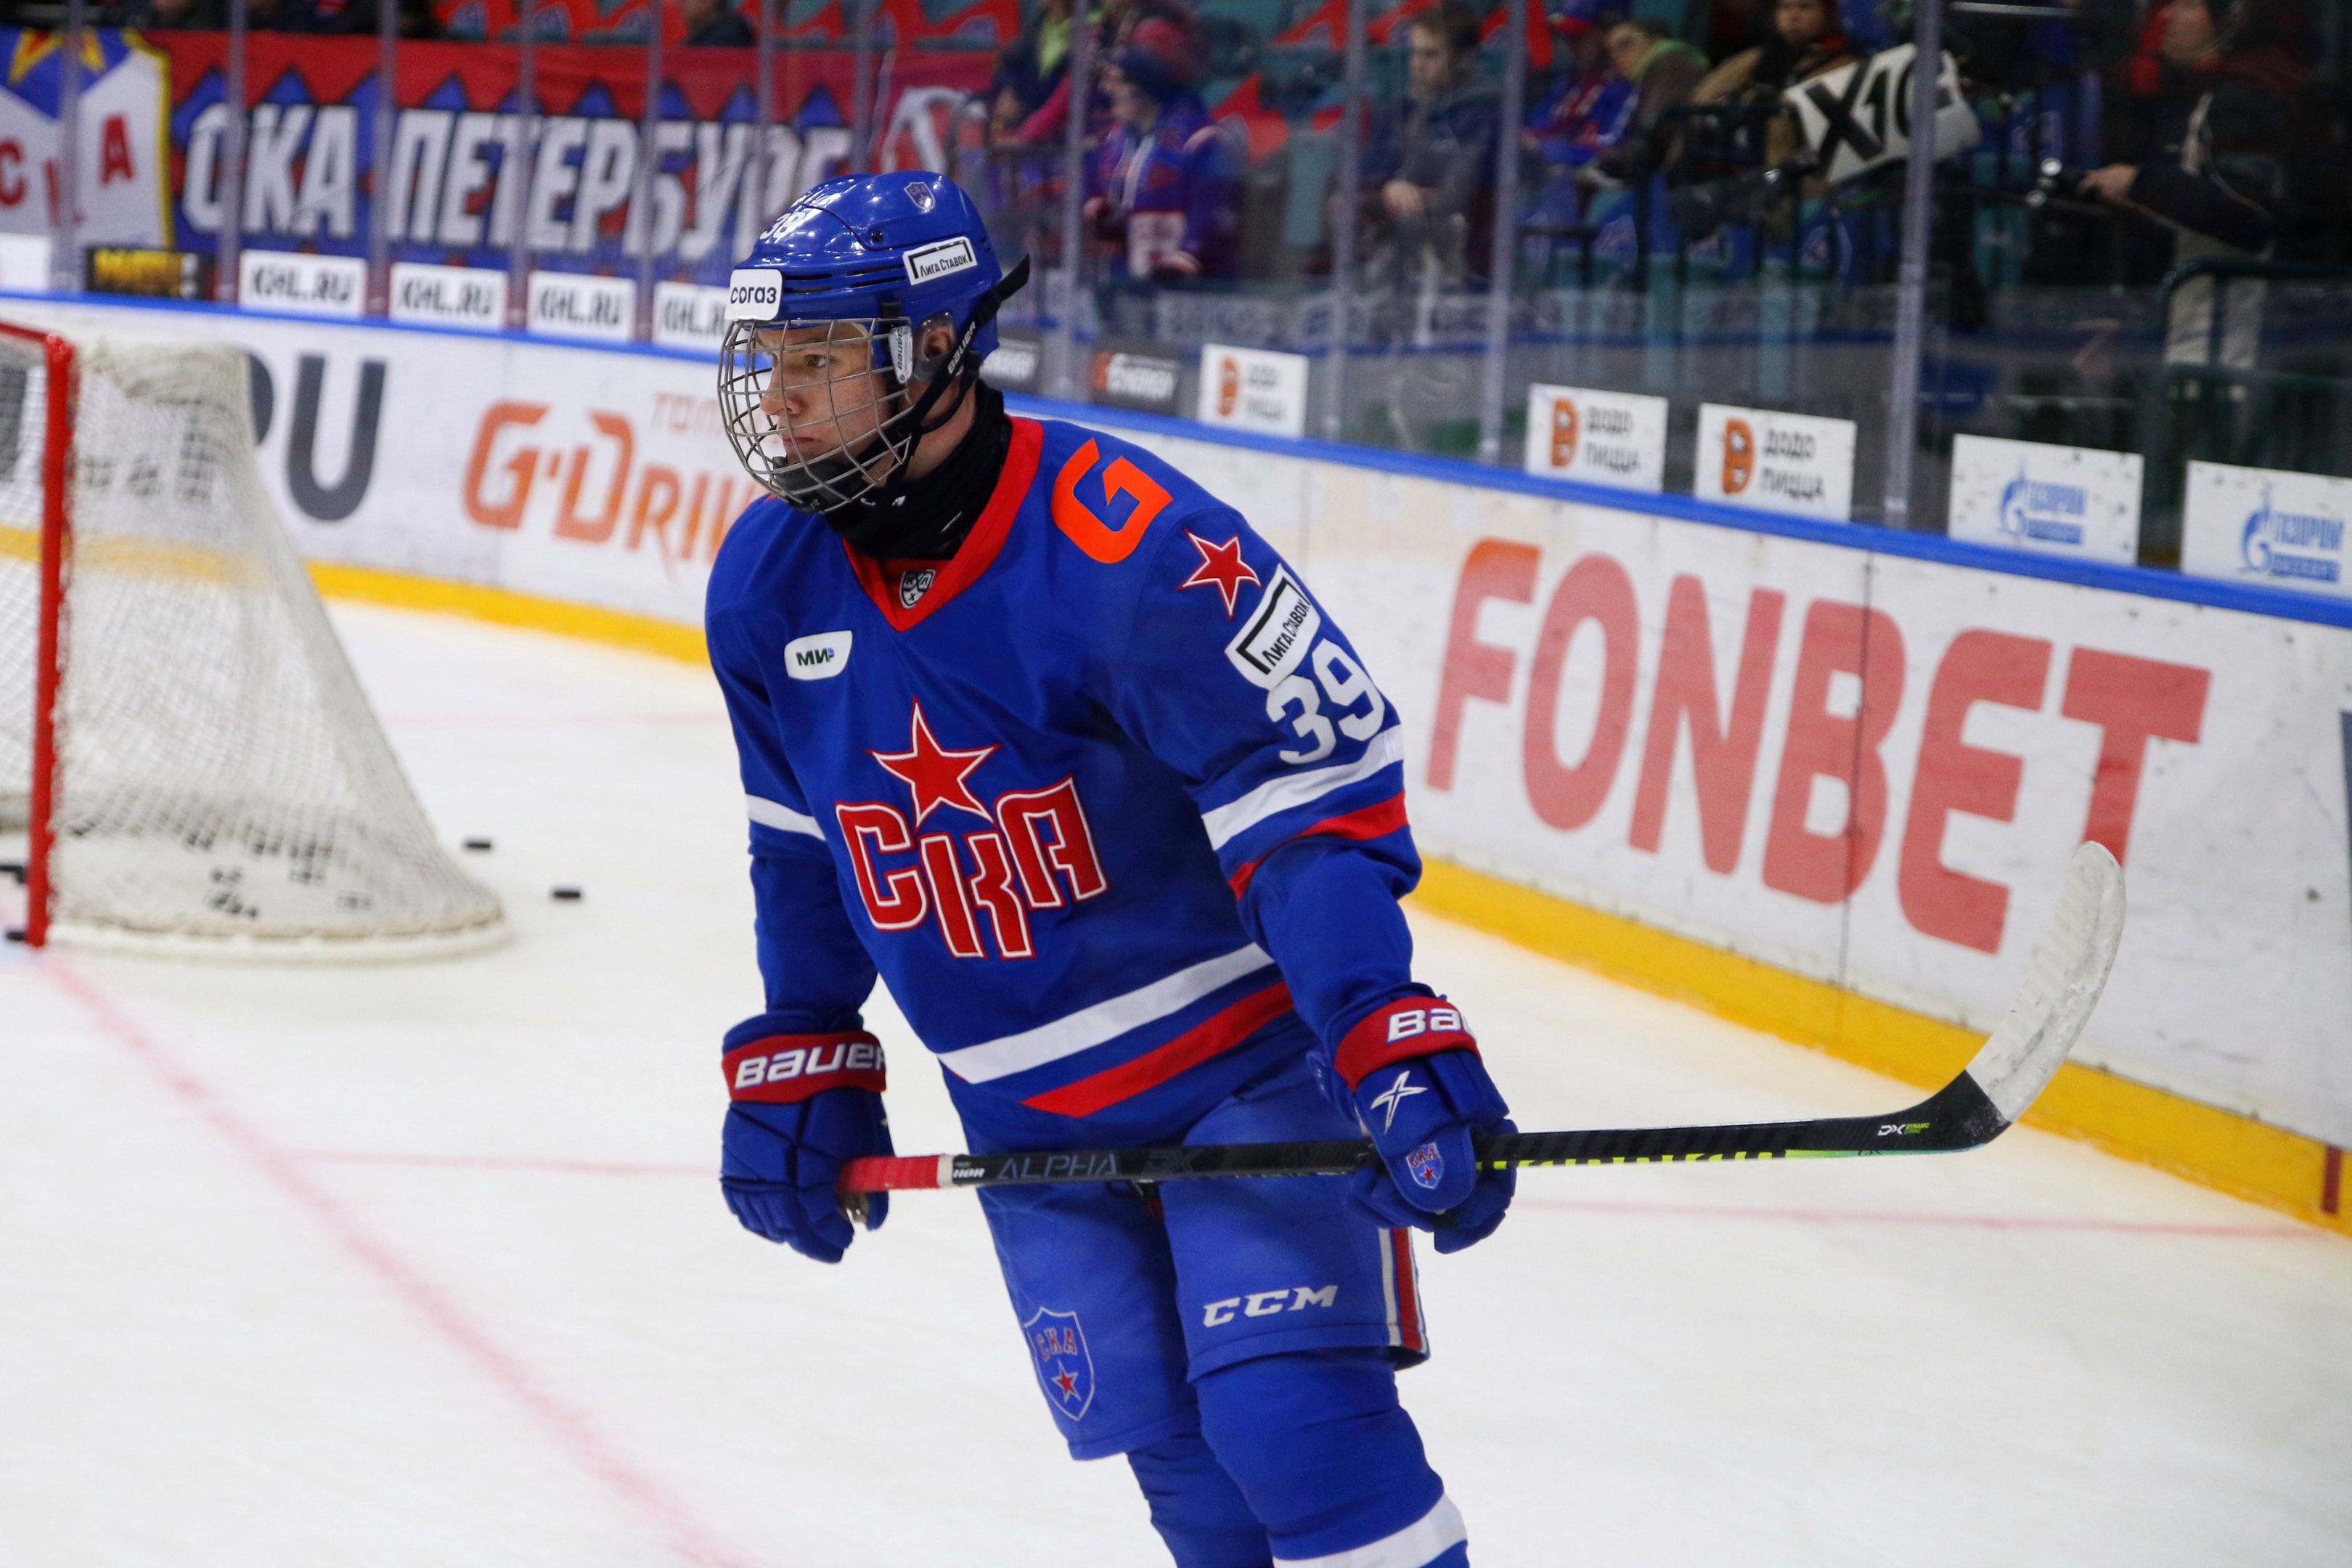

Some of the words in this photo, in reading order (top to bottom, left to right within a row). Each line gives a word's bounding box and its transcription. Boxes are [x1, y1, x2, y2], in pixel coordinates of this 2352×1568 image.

[183, 102, 356, 238] СКА
[387, 109, 852, 270] ПЕТЕРБУРГ
[663, 296, 726, 335] KHL.R
[730, 286, 777, 304] согаз
[1051, 438, 1173, 563] G
[796, 648, 835, 666] МИР
[1266, 638, 1385, 764] 39
[1426, 536, 2213, 958] FONBET
[836, 772, 1110, 959] СКА
[997, 1152, 1118, 1180] ALPHA
[1202, 1284, 1339, 1328] CCM
